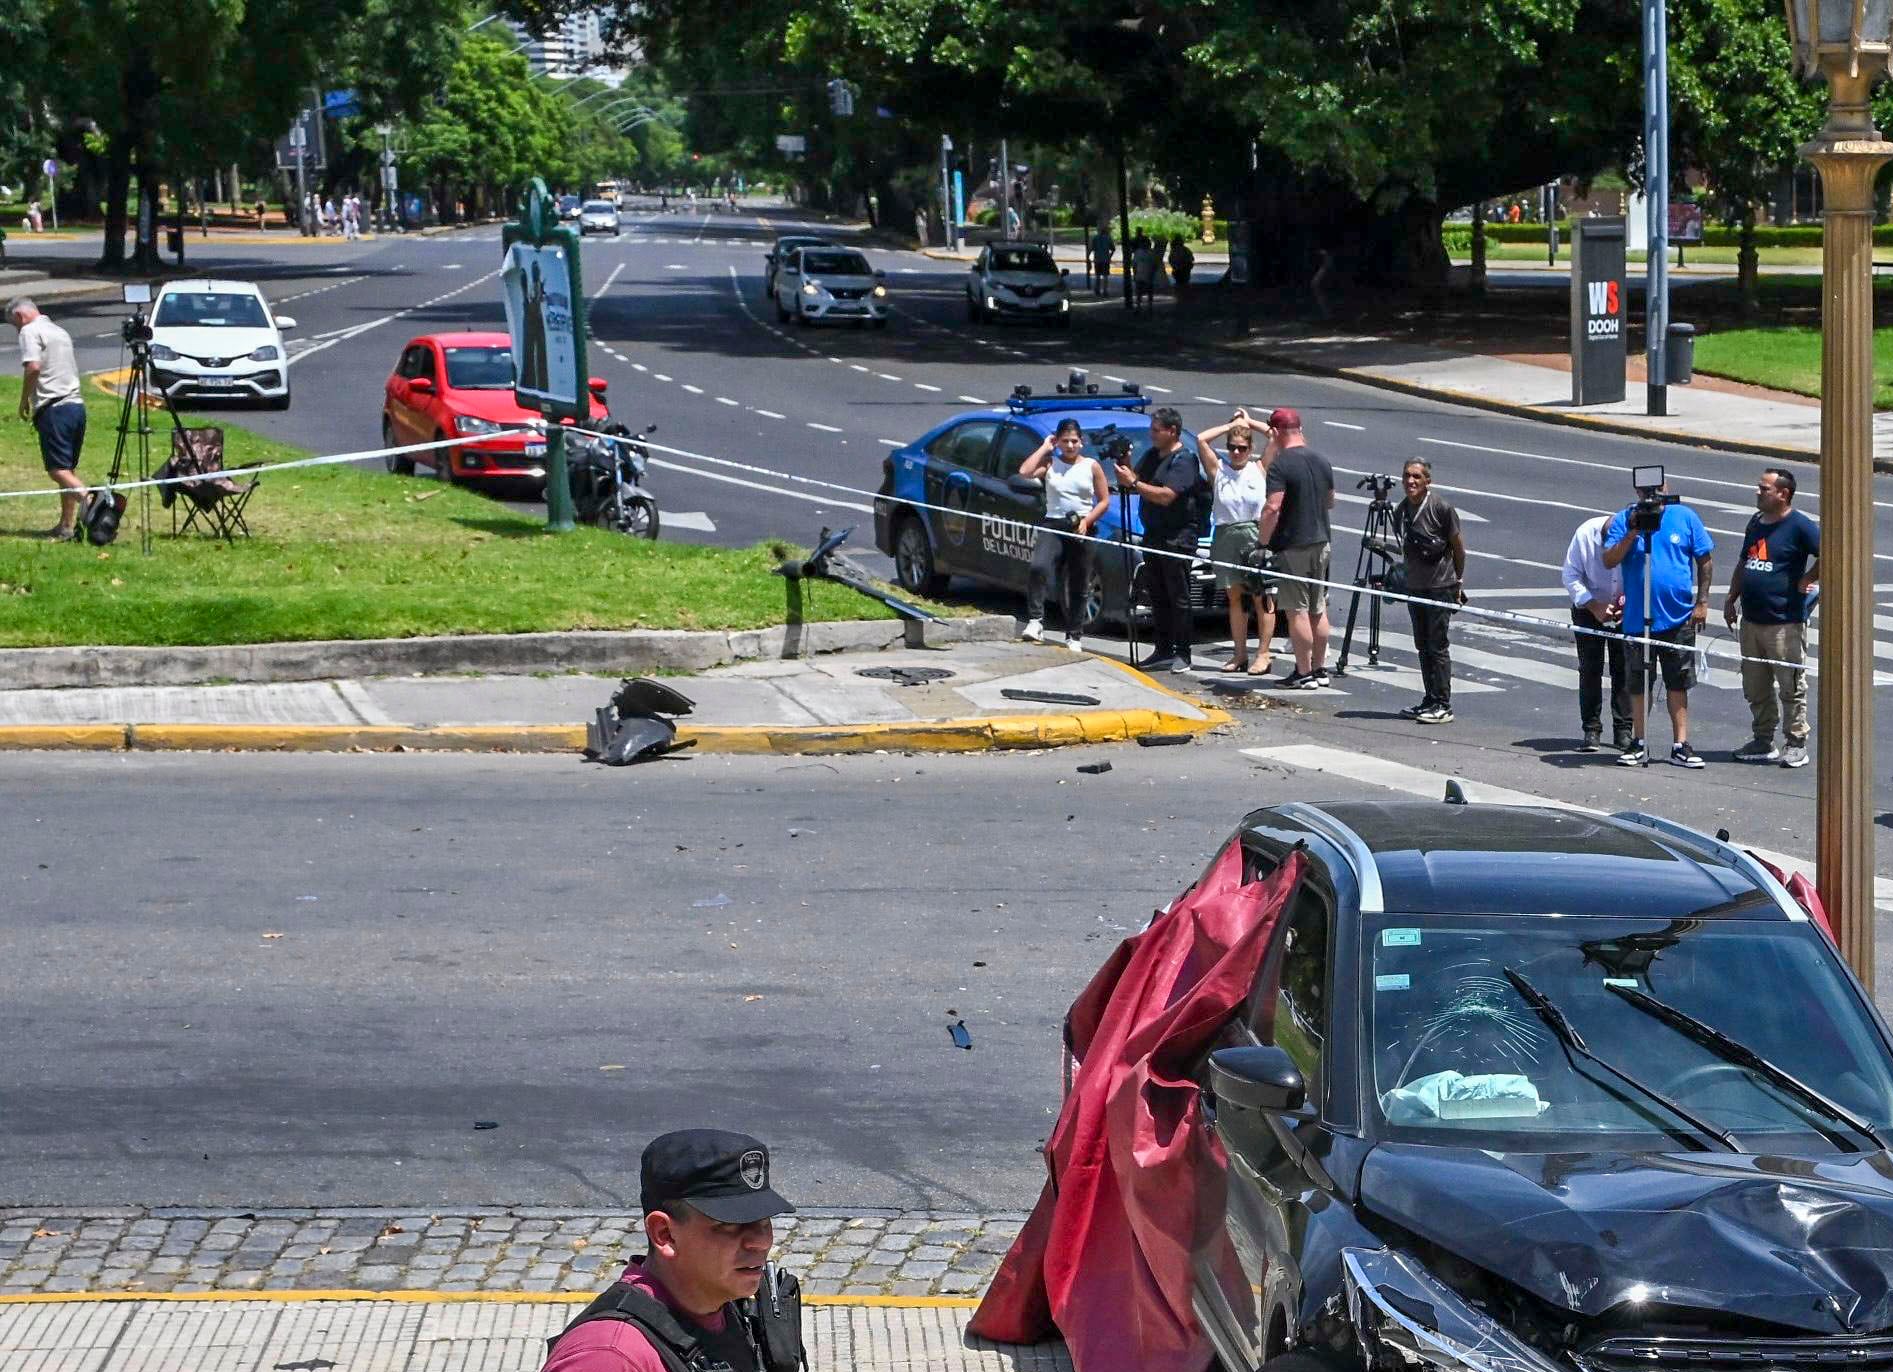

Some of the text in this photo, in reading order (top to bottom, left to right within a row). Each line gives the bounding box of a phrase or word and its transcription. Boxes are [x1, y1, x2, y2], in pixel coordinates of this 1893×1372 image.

[1588, 281, 1619, 315] WS
[1588, 319, 1619, 334] DOOH
[1009, 544, 1032, 562] CIUD
